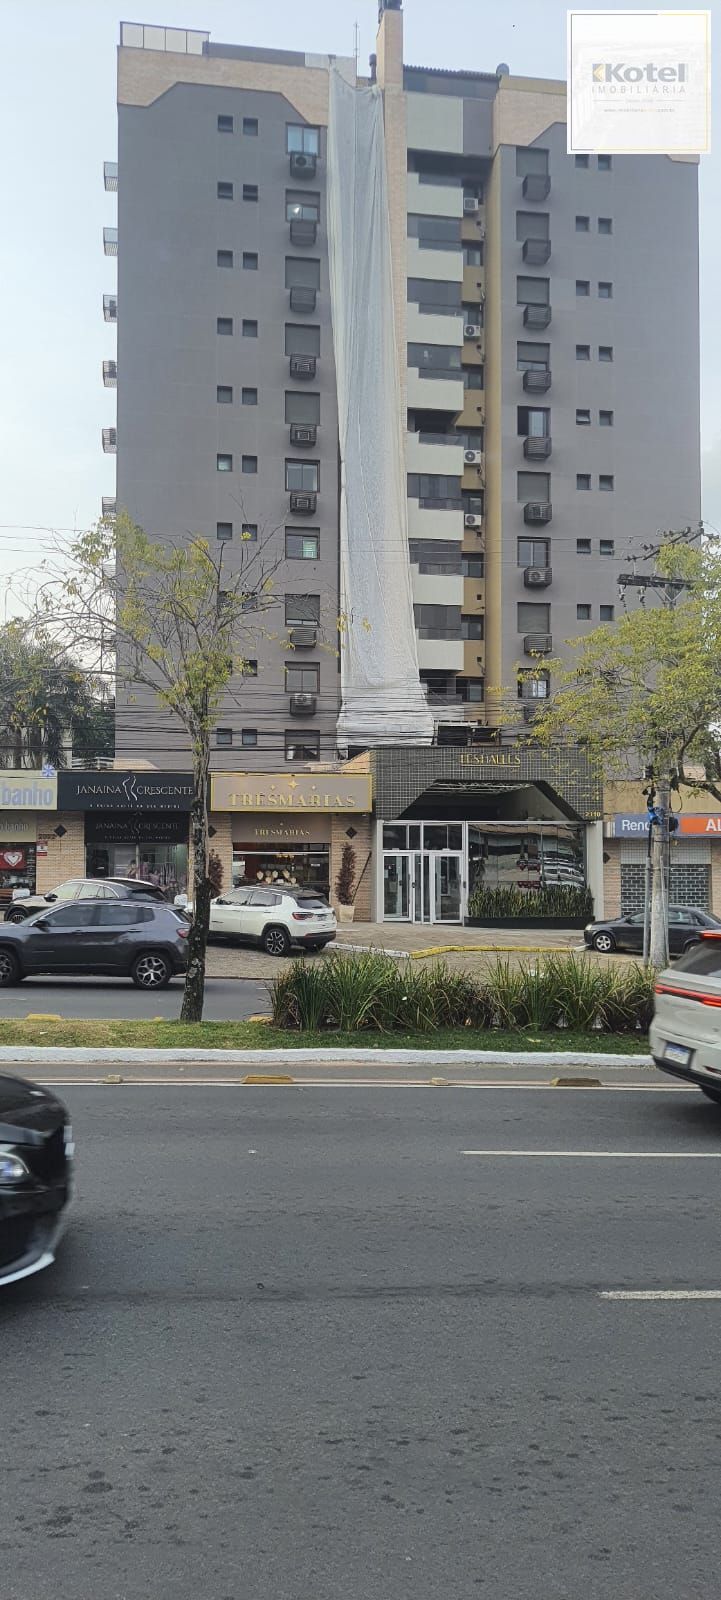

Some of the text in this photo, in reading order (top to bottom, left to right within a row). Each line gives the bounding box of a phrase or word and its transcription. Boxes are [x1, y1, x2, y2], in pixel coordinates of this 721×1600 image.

[76, 785, 194, 795] JANAINA CRESCENTE
[229, 792, 356, 807] TRESMARIAS
